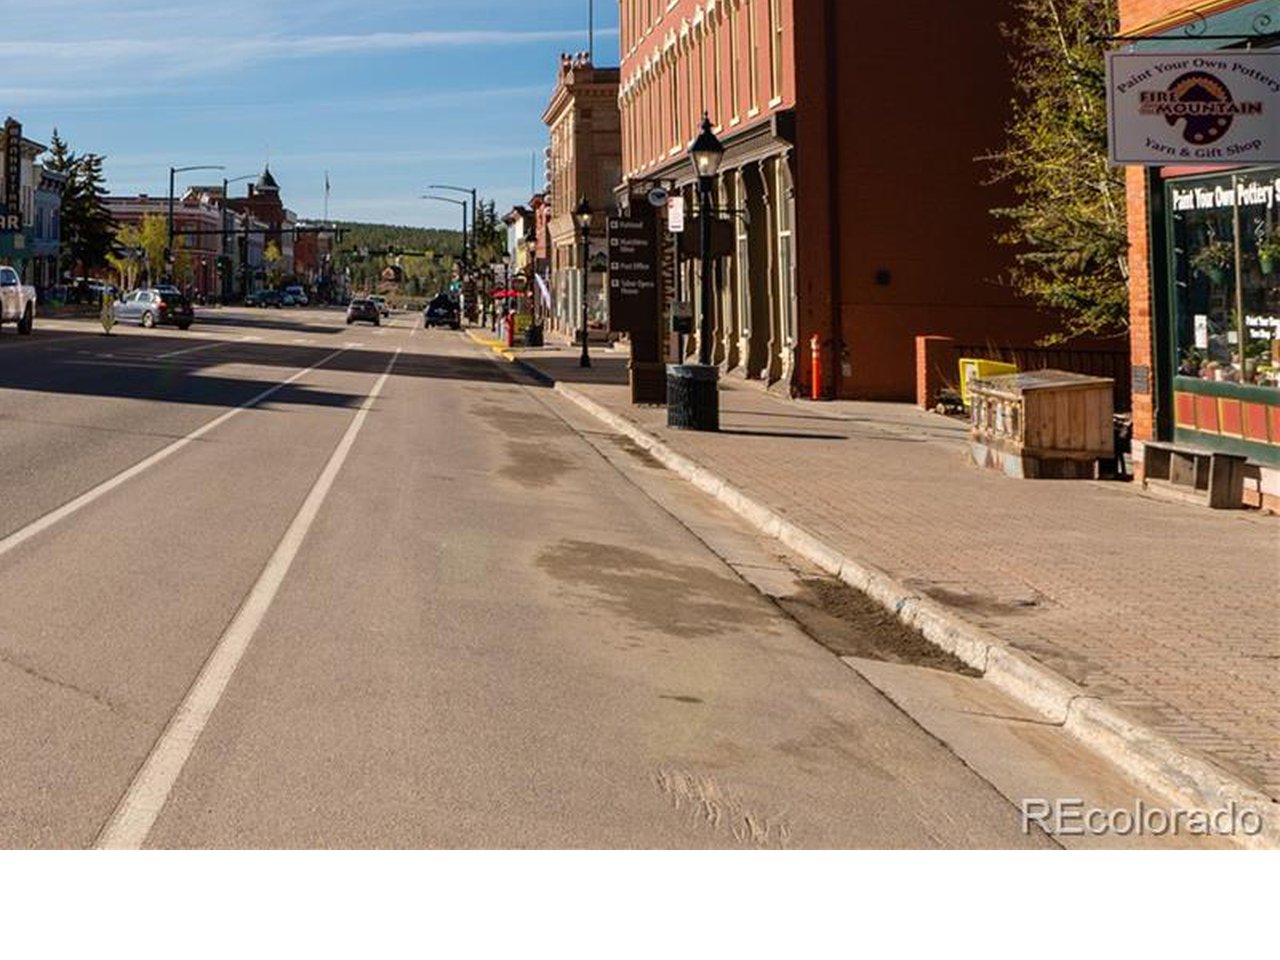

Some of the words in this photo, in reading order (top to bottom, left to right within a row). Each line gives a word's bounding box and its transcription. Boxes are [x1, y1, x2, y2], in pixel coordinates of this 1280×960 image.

[1116, 69, 1152, 93] Paint
[1154, 59, 1190, 74] Your
[1193, 58, 1227, 69] Own
[1140, 91, 1177, 103] FIRE
[1156, 101, 1263, 115] MOUNTAIN
[1145, 137, 1176, 155] Yarn
[1179, 147, 1190, 157] &
[1194, 147, 1222, 158] Gift
[1226, 138, 1263, 156] Shop
[1173, 190, 1194, 210] Paint
[1195, 188, 1214, 209] Your
[1237, 182, 1273, 209] Pottery
